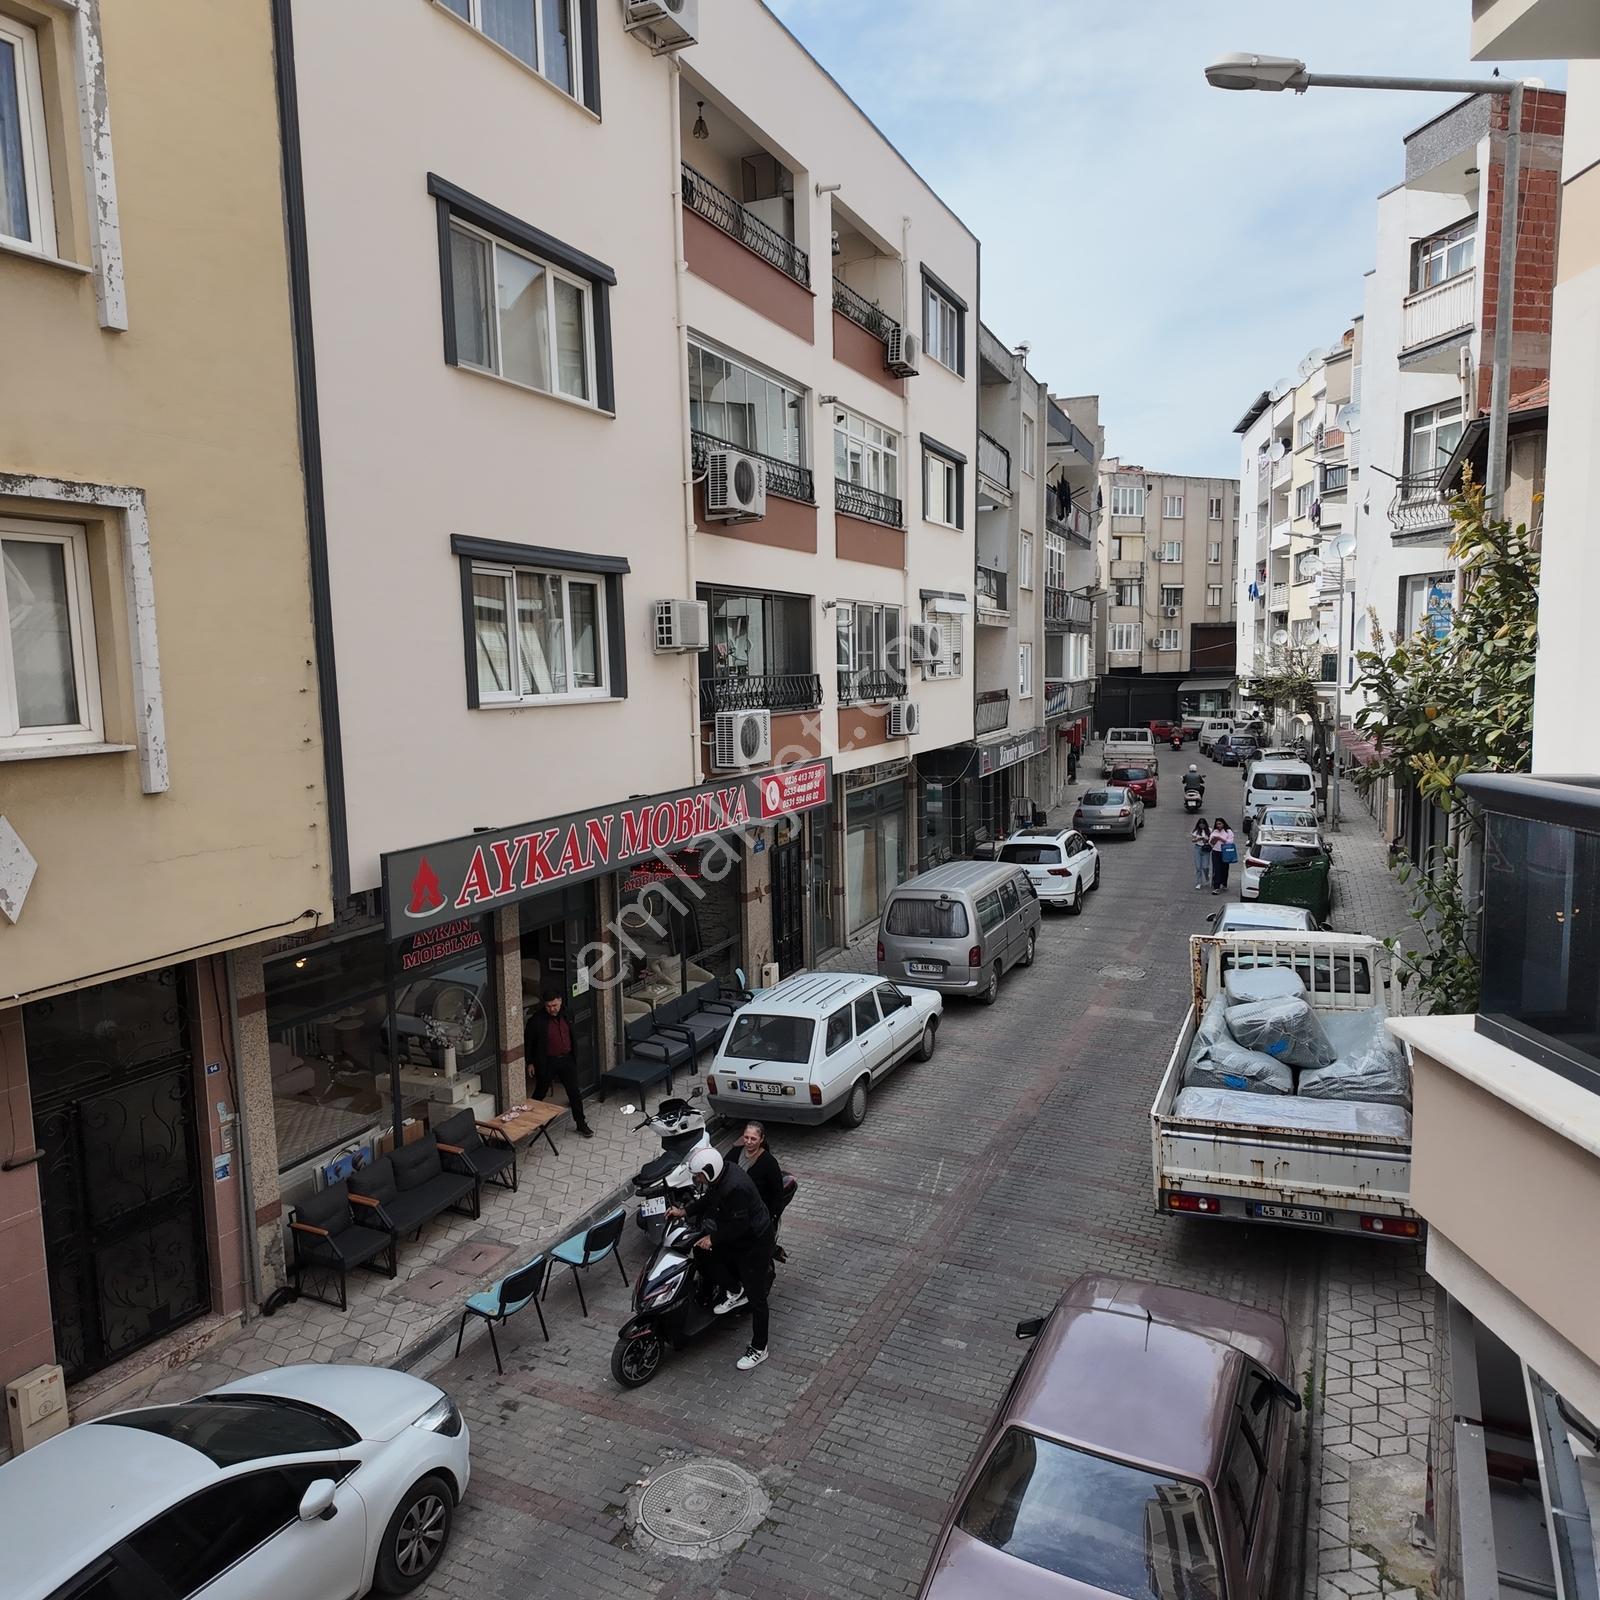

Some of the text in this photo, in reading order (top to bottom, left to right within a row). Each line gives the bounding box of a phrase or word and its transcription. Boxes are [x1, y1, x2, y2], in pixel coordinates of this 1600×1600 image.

[454, 814, 613, 910] AYKAN
[413, 917, 472, 948] AYKAN
[767, 1085, 779, 1093] 593
[1263, 1206, 1320, 1221] 45 NZ 310
